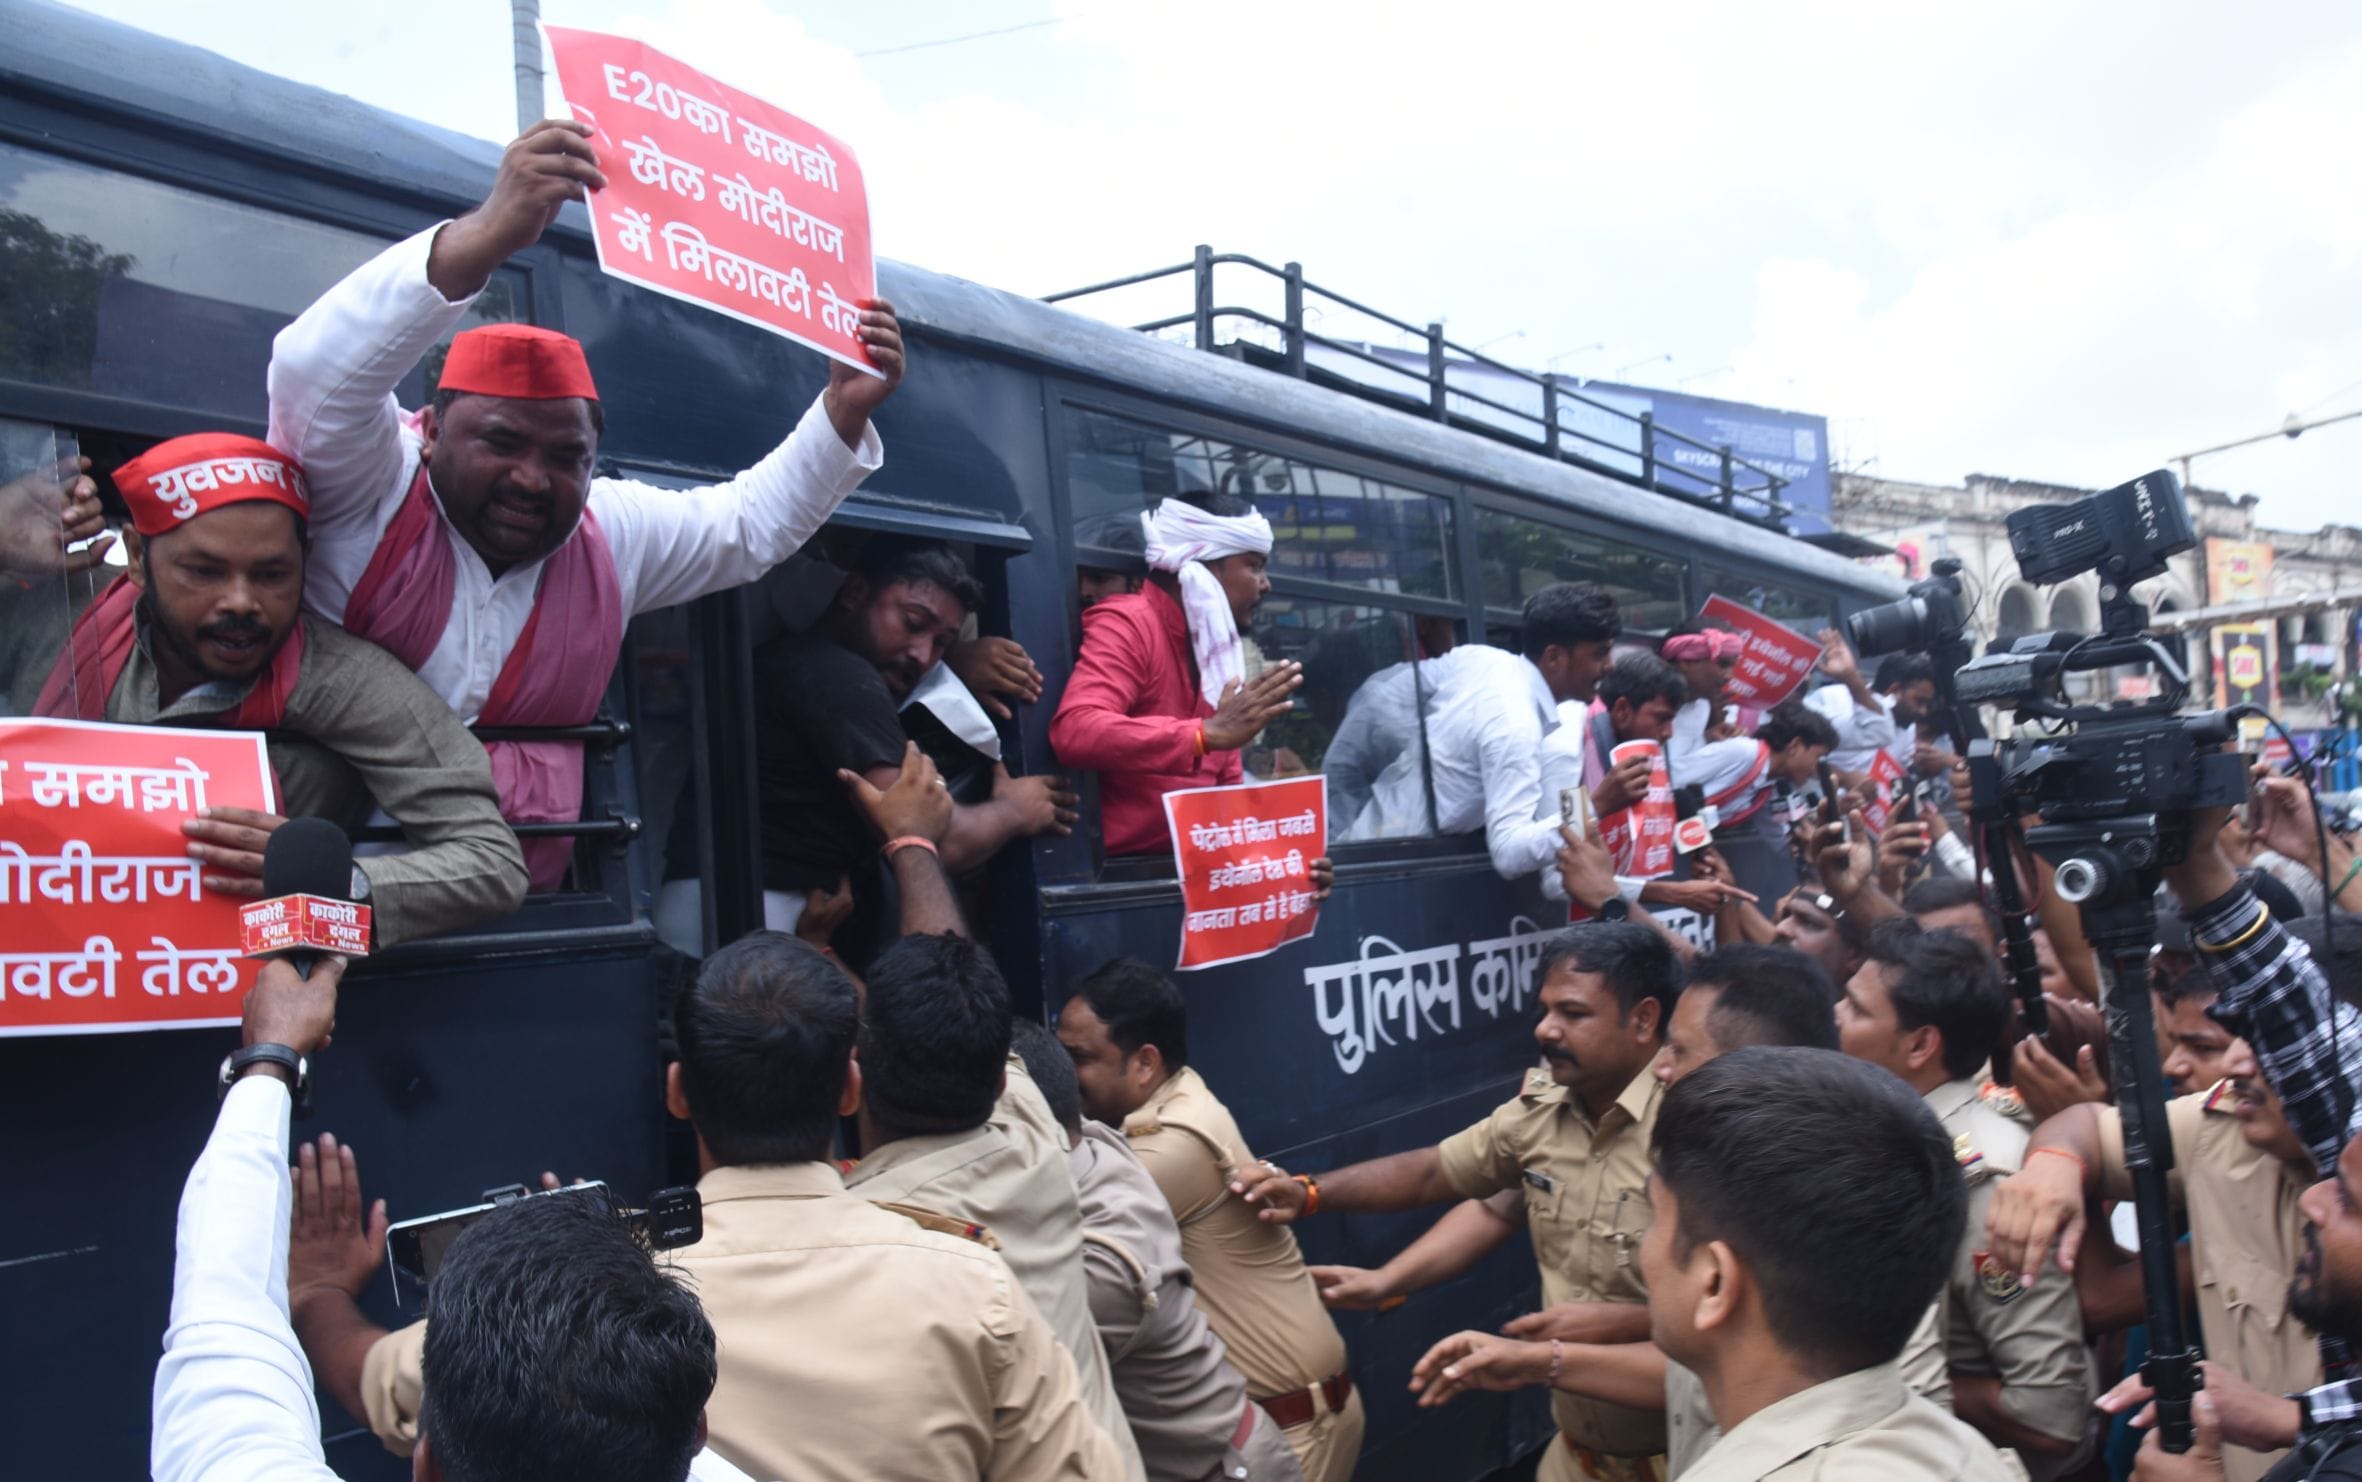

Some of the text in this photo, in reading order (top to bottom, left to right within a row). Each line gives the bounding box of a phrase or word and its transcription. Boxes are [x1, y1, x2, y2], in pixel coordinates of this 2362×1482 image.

[604, 63, 838, 192] E20का समझो
[622, 135, 844, 263] खेल मोदीराज
[610, 207, 653, 262] में
[660, 221, 812, 319] मिलावटी
[148, 457, 287, 519] युवजन
[24, 757, 209, 812] समझो
[243, 901, 286, 926] काकोरी
[261, 922, 289, 939] दंगल
[308, 901, 358, 925] काकोरी
[328, 923, 362, 941] दंगल
[137, 936, 242, 996] तेल
[269, 935, 294, 948] News
[337, 939, 366, 952] News
[1304, 935, 1460, 1074] पुलिस
